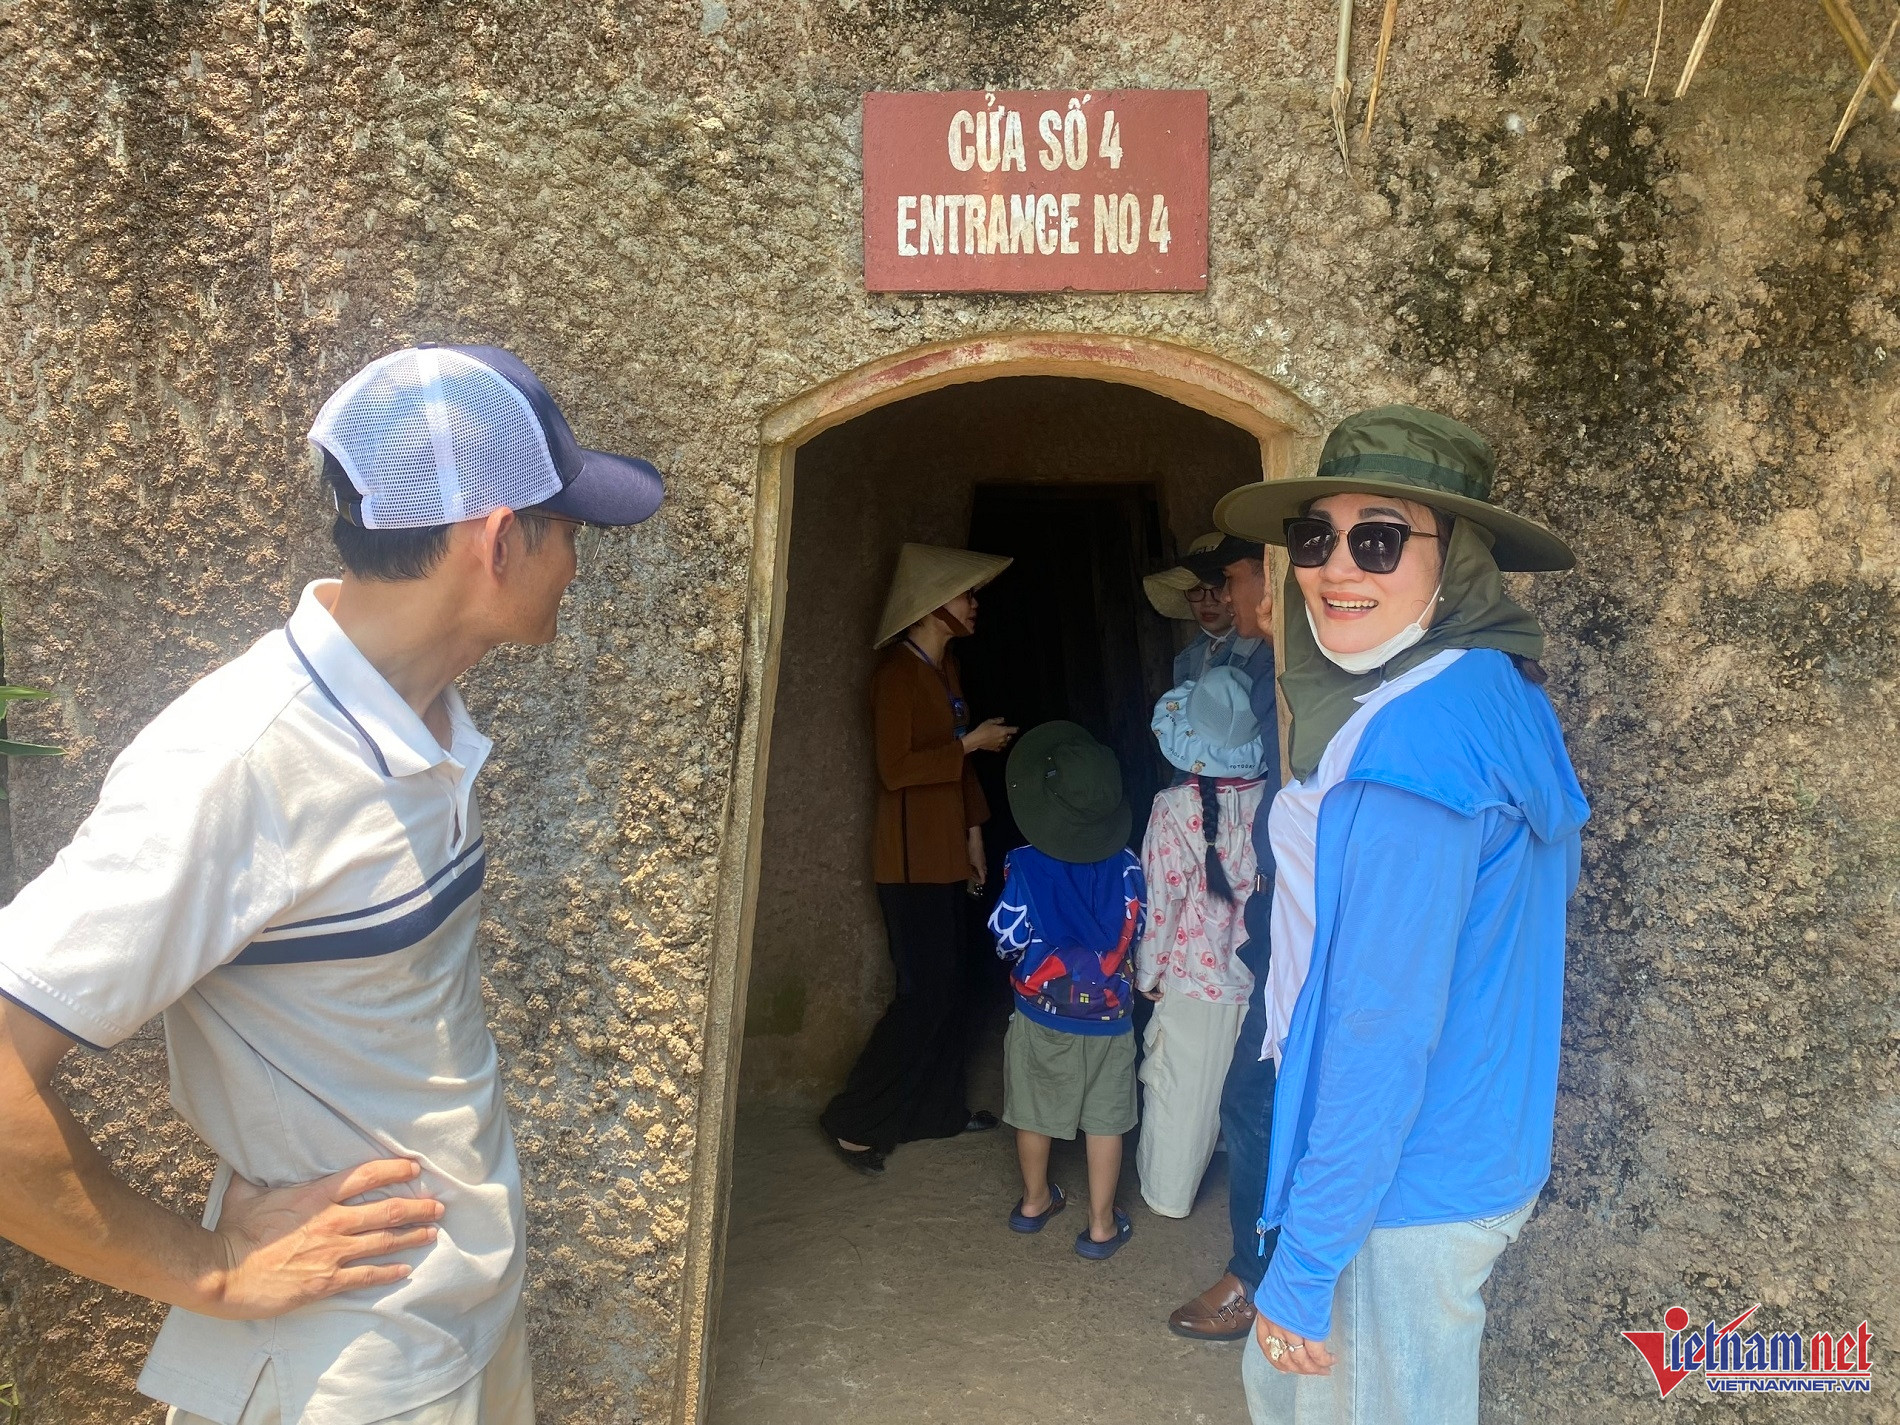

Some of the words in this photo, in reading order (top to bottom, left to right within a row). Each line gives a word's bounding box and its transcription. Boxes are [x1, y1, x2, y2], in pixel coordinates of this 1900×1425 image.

[948, 93, 1026, 172] CỬA
[1039, 94, 1092, 171] SỐ
[1099, 110, 1123, 169] 4
[897, 193, 1081, 257] ENTRANCE
[1094, 193, 1140, 255] NO
[1149, 194, 1172, 253] 4
